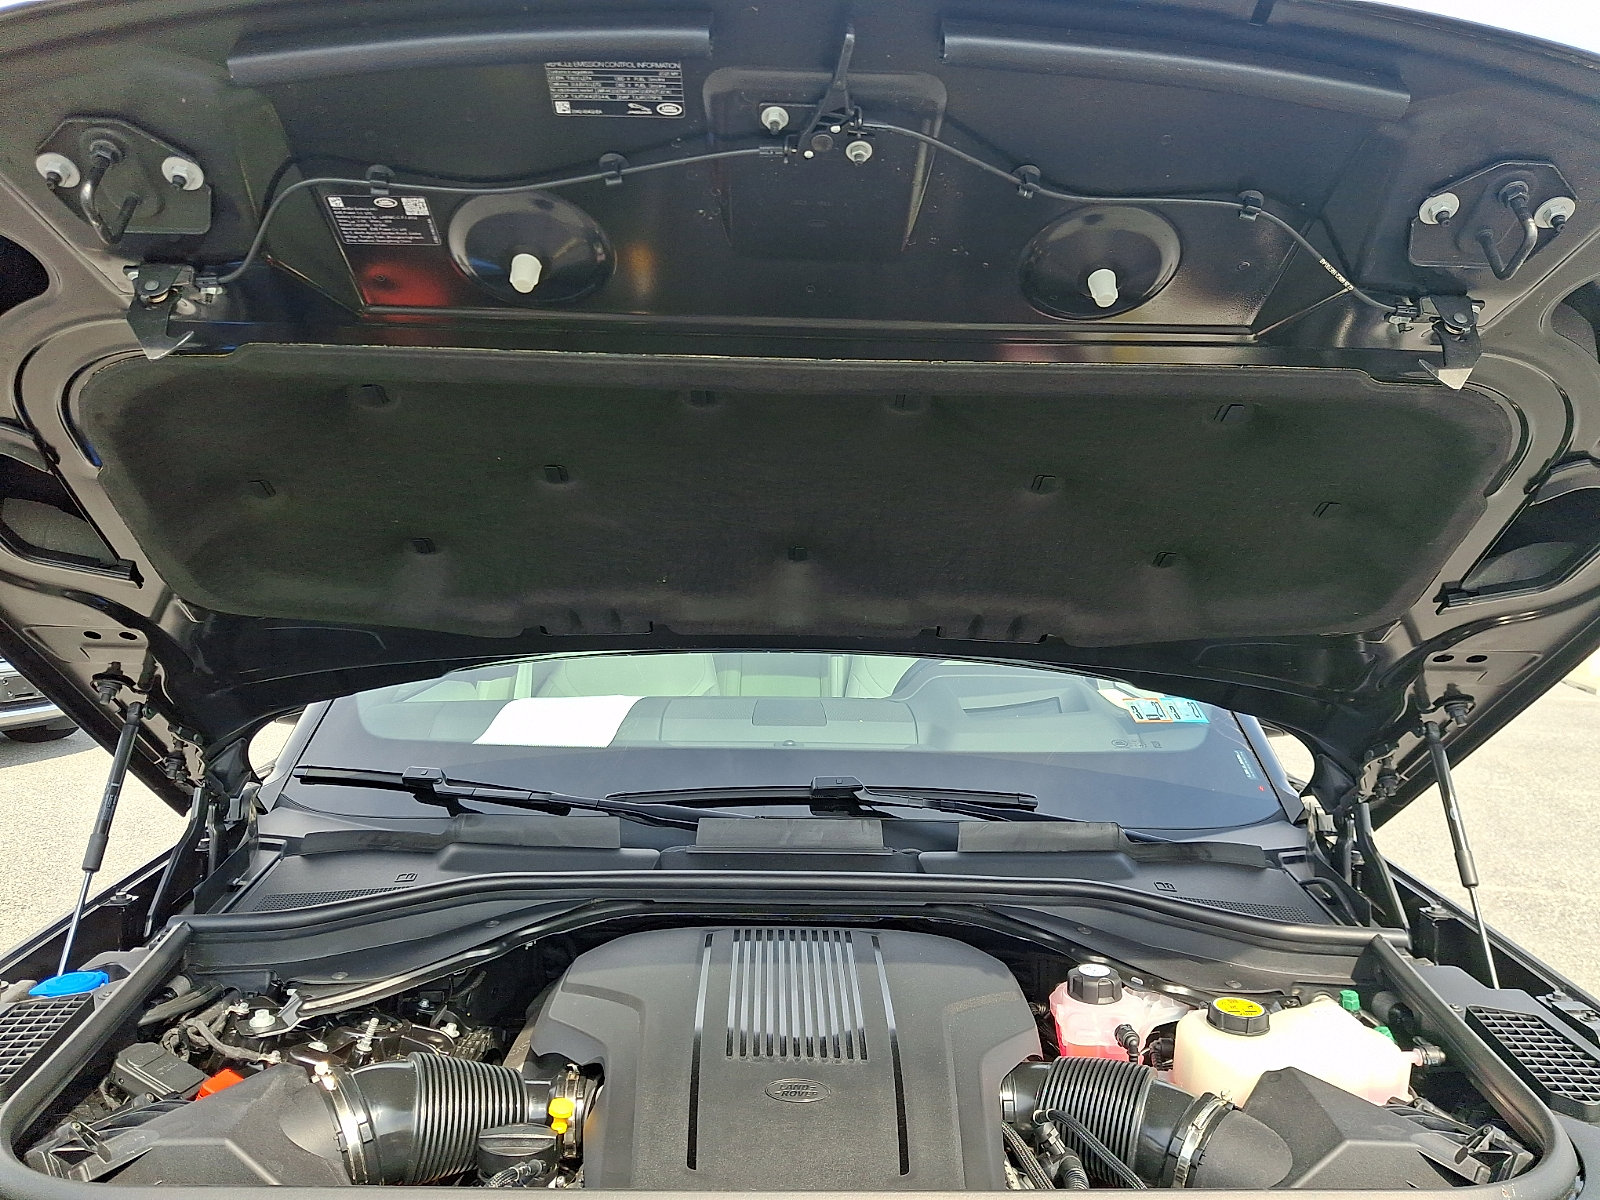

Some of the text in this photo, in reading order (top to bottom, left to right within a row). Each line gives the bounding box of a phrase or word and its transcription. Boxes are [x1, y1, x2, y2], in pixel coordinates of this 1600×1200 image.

[605, 61, 636, 69] CONTROL
[1131, 705, 1143, 720] 3
[1169, 705, 1181, 720] 3
